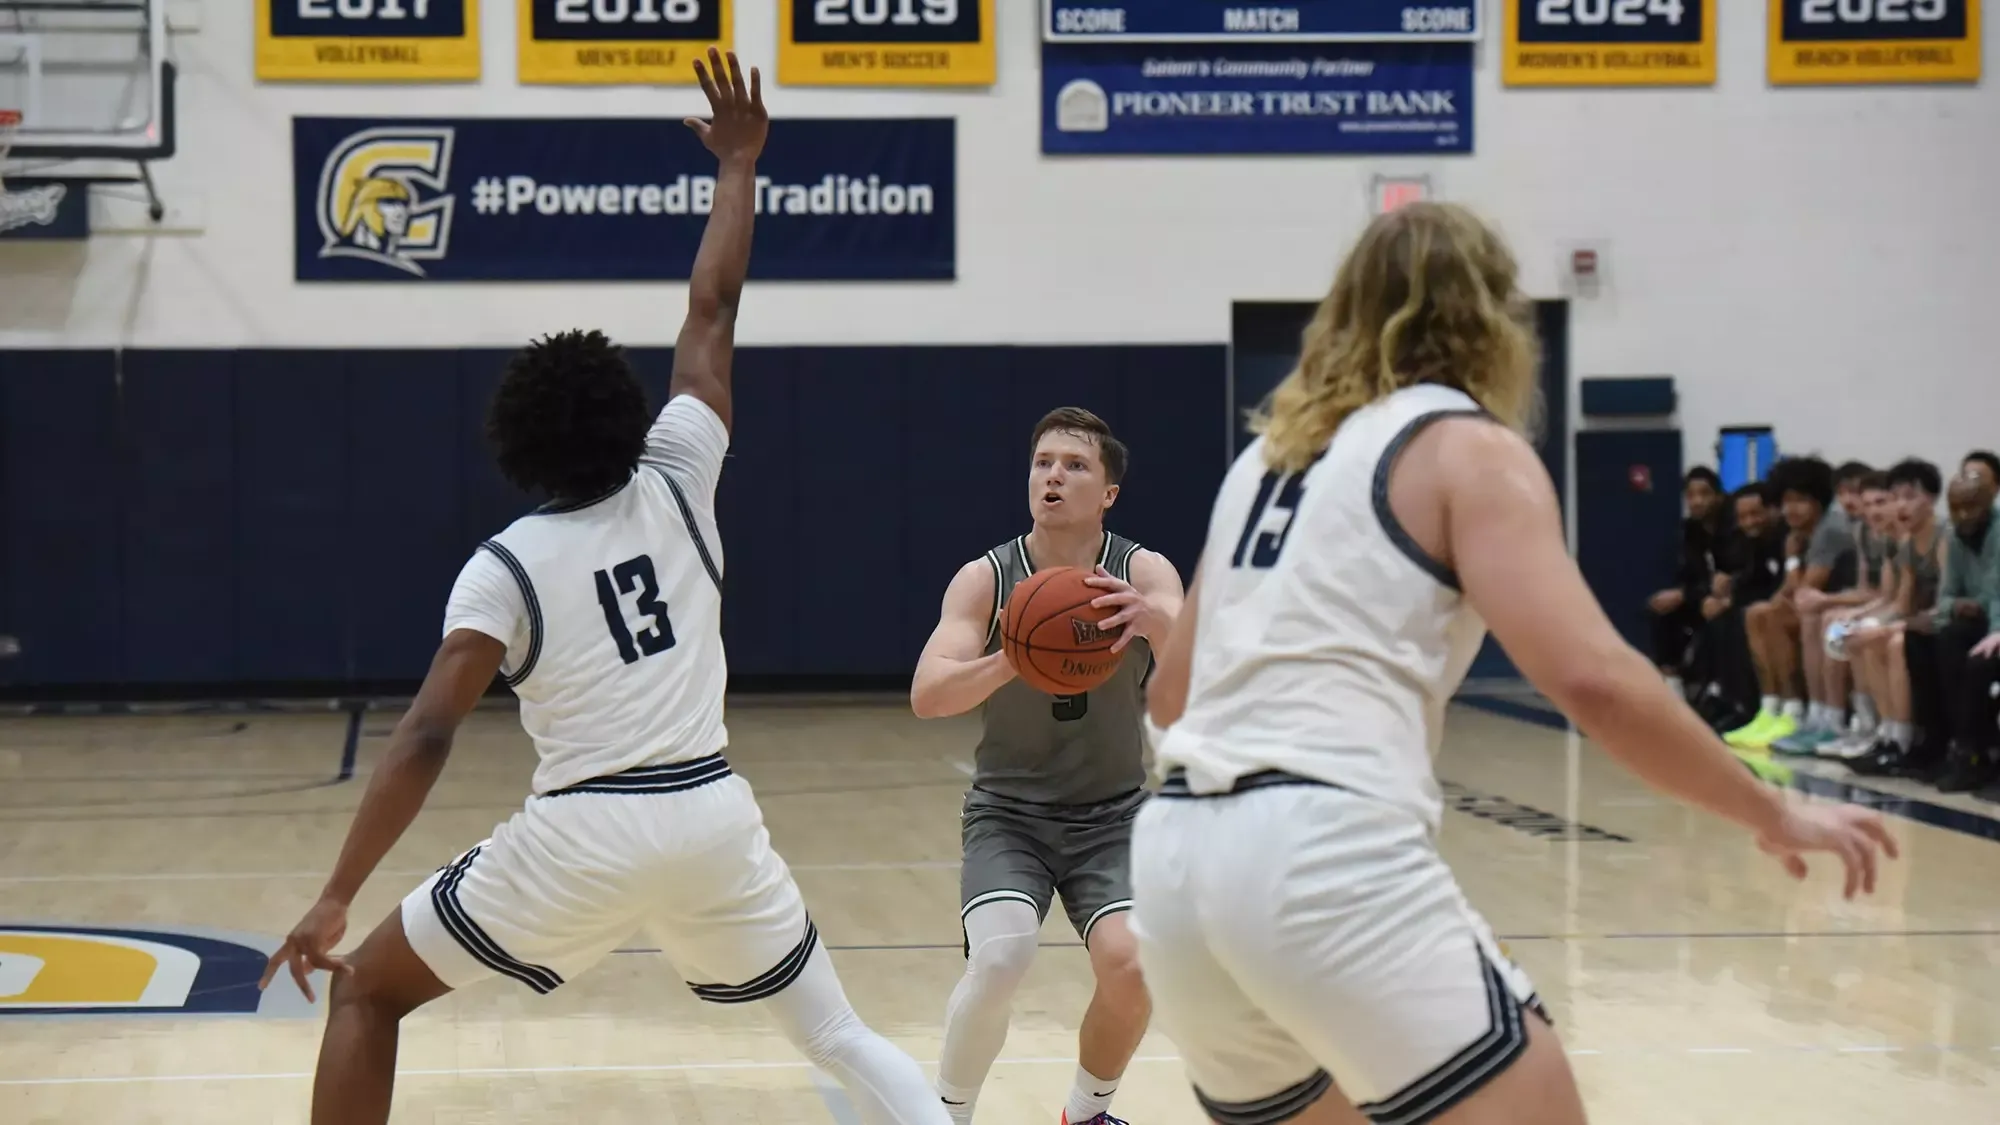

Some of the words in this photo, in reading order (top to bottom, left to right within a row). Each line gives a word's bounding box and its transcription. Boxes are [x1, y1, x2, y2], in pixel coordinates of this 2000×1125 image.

[1056, 8, 1126, 32] SCORE
[1224, 8, 1299, 31] MATCH
[1401, 7, 1471, 32] SCORE
[314, 45, 420, 63] VOLLEYBALL
[634, 48, 676, 66] GOLF
[882, 51, 949, 69] SOCCER
[1602, 51, 1704, 69] VOLLEYBALL
[1213, 59, 1309, 79] Community
[1311, 58, 1375, 77] Partner
[1113, 91, 1255, 116] PIONEER
[1257, 90, 1363, 116] TRUST
[1366, 90, 1457, 116] BANK
[472, 174, 933, 214] #PoweredBTradition
[594, 554, 676, 665] 13
